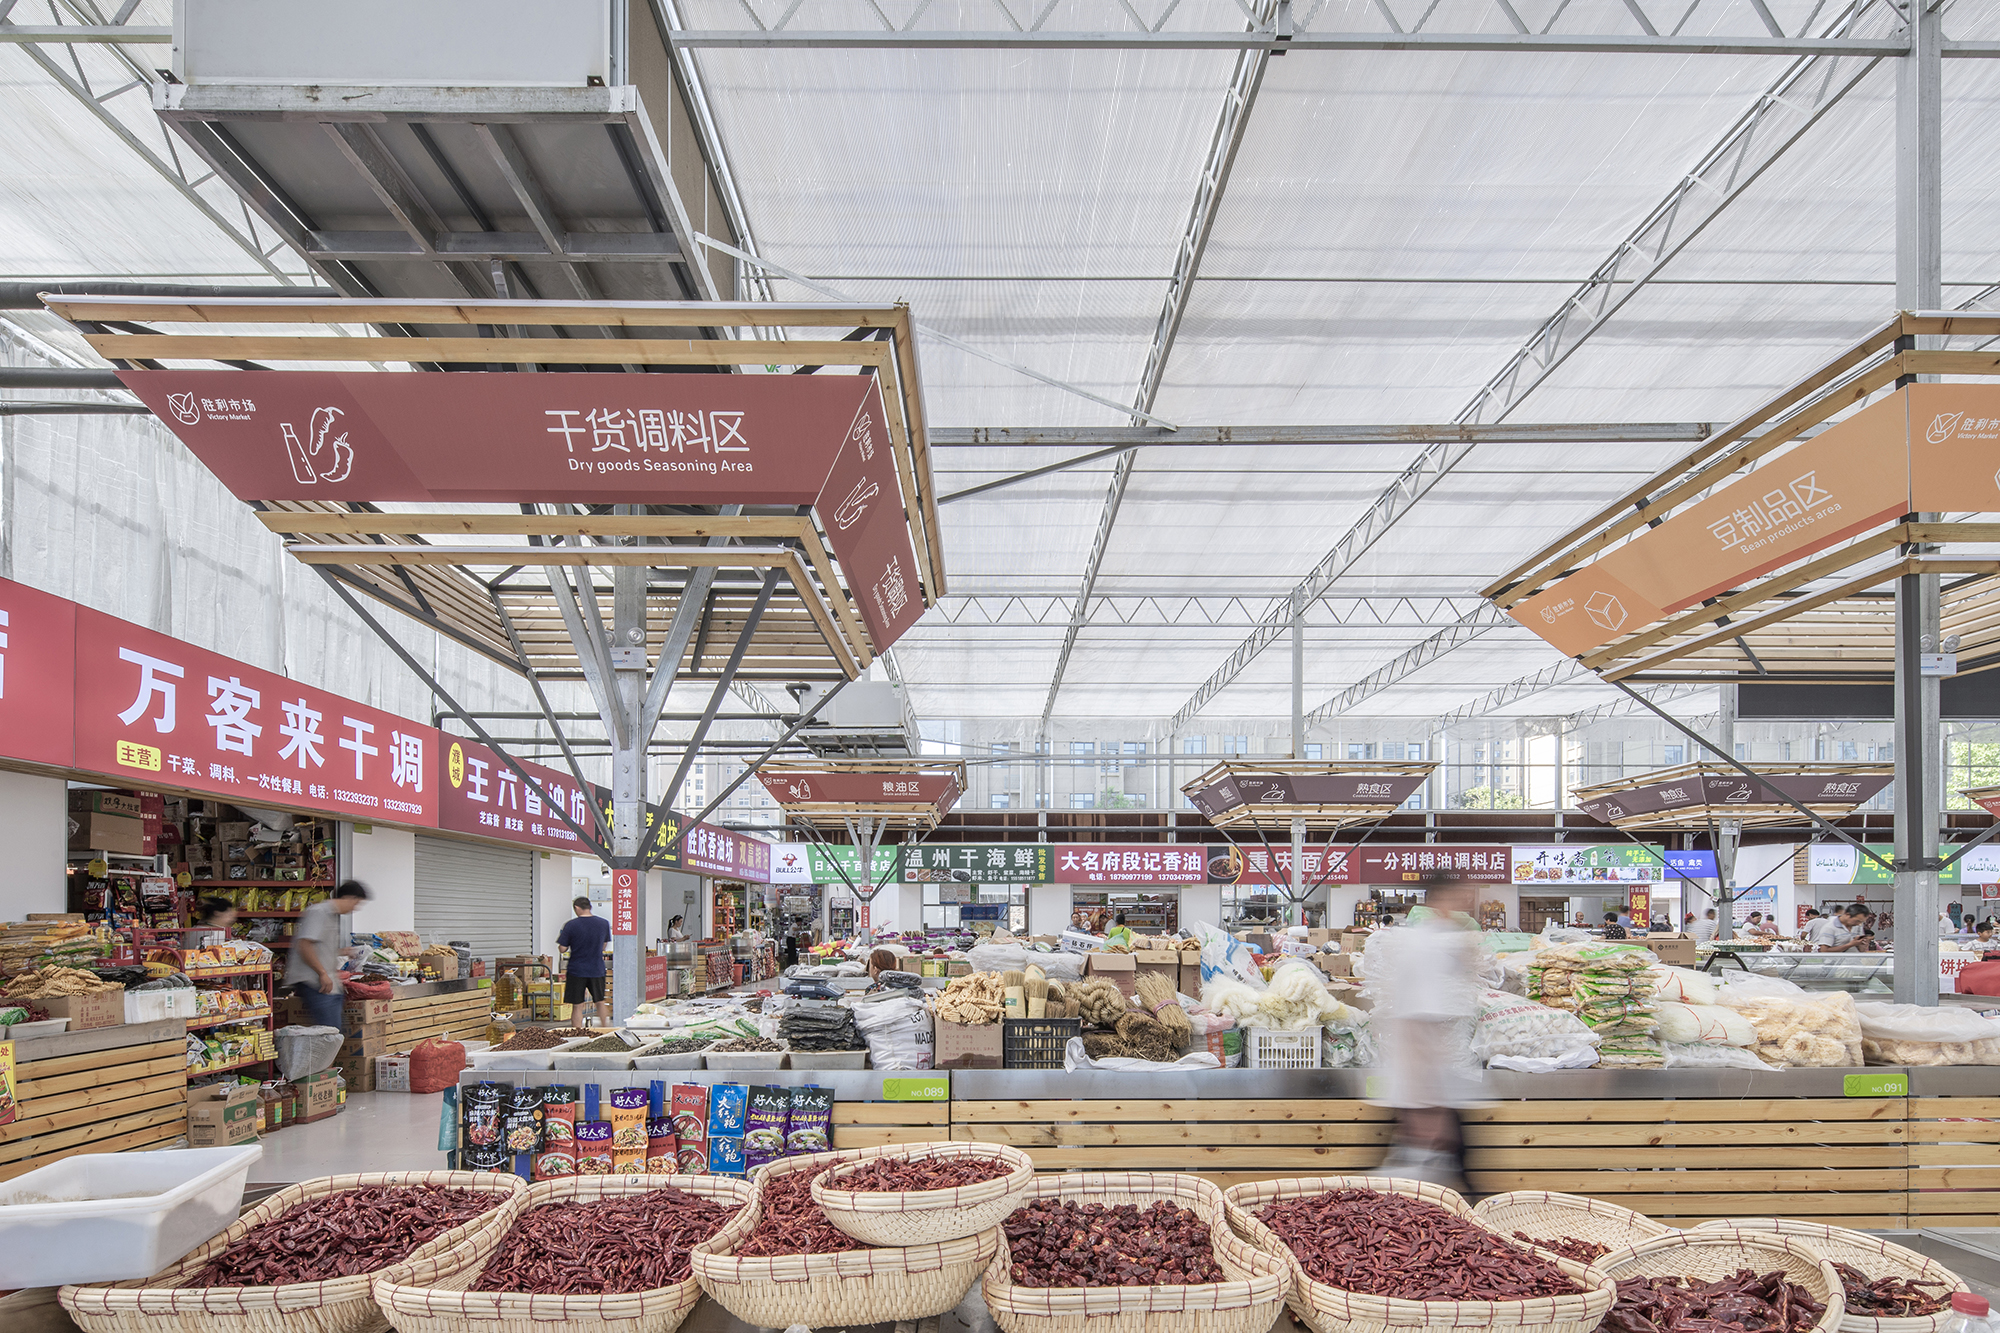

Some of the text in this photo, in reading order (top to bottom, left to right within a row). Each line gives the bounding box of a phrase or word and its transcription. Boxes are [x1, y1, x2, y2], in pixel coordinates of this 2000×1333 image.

[201, 398, 257, 412] 胜利市场
[207, 413, 228, 421] Victory
[545, 408, 750, 454] 干货调料区
[568, 458, 753, 475] Dry goods Seasoning Area
[1706, 470, 1833, 551] 豆制品区
[1740, 503, 1842, 554] Bean products area
[117, 646, 424, 794] 万客来干调
[882, 781, 919, 792] 粮油区
[1356, 783, 1393, 794] 熟食区
[1822, 783, 1861, 793] 熟食区
[333, 789, 378, 807] 13323932373
[905, 848, 1034, 868] 温州干海鲜
[1038, 849, 1046, 880] 批发零售
[1061, 851, 1201, 871] 大名府段记香油
[1248, 851, 1349, 872] 重庆面条
[1366, 852, 1506, 871] 一分利粮油调料店
[622, 888, 632, 931] 禁止吸烟
[1631, 895, 1647, 927] 馒头
[911, 1087, 944, 1097] NO.089
[1871, 1083, 1902, 1093] NO.091
[543, 1092, 571, 1102] 好人家
[614, 1094, 643, 1107] 好人家
[754, 1094, 789, 1109] 好人家
[793, 1094, 828, 1107] 好人家
[577, 1126, 608, 1138] 好人家
